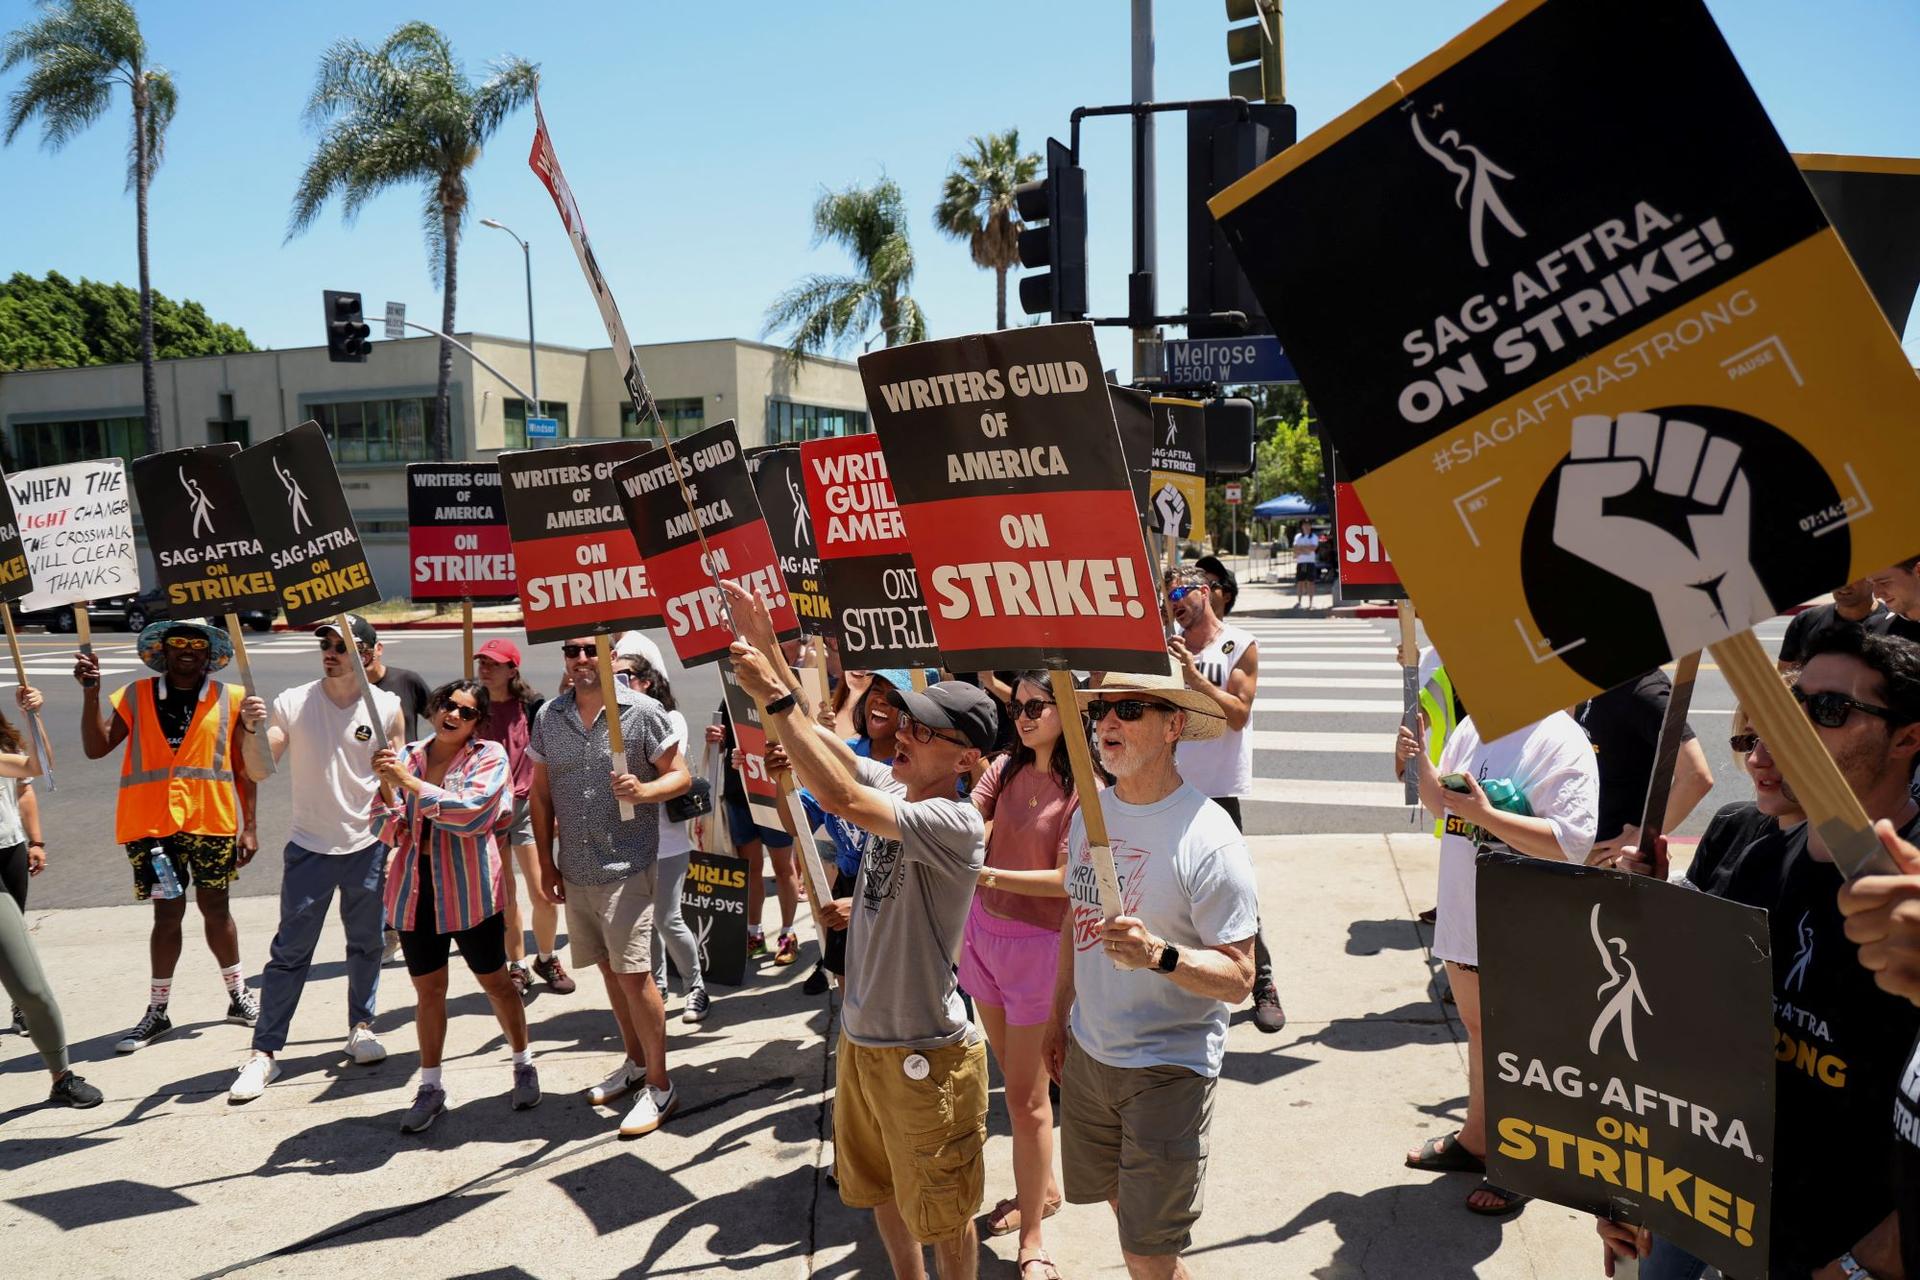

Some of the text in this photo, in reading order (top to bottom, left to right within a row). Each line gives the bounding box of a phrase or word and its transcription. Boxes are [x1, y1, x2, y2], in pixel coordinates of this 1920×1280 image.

[1398, 216, 1735, 424] ON STRIKE!
[1174, 343, 1256, 366] Melrose
[1727, 349, 1775, 381] PAUSE
[879, 360, 1089, 414] WRITERS GUILD
[1174, 365, 1231, 382] 5500 W
[1431, 289, 1758, 474] #SAGAFTRASTRONG
[528, 423, 554, 433] Windsor
[980, 411, 1008, 439] OF
[510, 465, 592, 489] WRITERS
[622, 439, 736, 499] WRITERS GUILD
[812, 451, 889, 486] WRIT
[947, 444, 1070, 484] AMERICA
[1161, 459, 1196, 472] STRIKE!
[10, 471, 122, 505] WHEN THE
[413, 473, 503, 487] WRITERS GUIL
[681, 483, 699, 504] OF
[456, 491, 471, 502] OF
[572, 488, 591, 503] OF
[825, 482, 899, 514] GUIL
[434, 506, 494, 520] AMERICA
[546, 505, 624, 530] AMERICA
[827, 510, 907, 544] AMER
[23, 525, 131, 552] THE CROSSWALK
[454, 534, 478, 550] ON
[1000, 513, 1050, 550] ON
[72, 543, 132, 564] CLEAR
[311, 558, 330, 574] ON
[414, 553, 517, 582] STRIKE!
[575, 543, 607, 565] ON
[700, 548, 731, 577] ON
[46, 566, 121, 594] THANKS
[206, 563, 229, 576] ON
[168, 571, 276, 604] STRIKE!
[282, 561, 371, 610] STRIKE!
[527, 565, 656, 612] STRIKE
[802, 579, 818, 592] ON
[882, 568, 918, 600] ON
[931, 557, 1145, 620] STRIKE!
[789, 592, 832, 619] TRIK
[843, 605, 939, 652] STRI
[687, 863, 746, 889] STRIK
[697, 882, 713, 894] ON
[1770, 1025, 1848, 1088] ONG
[1596, 1116, 1648, 1148] ON
[1497, 1117, 1755, 1247] STRIKE!
